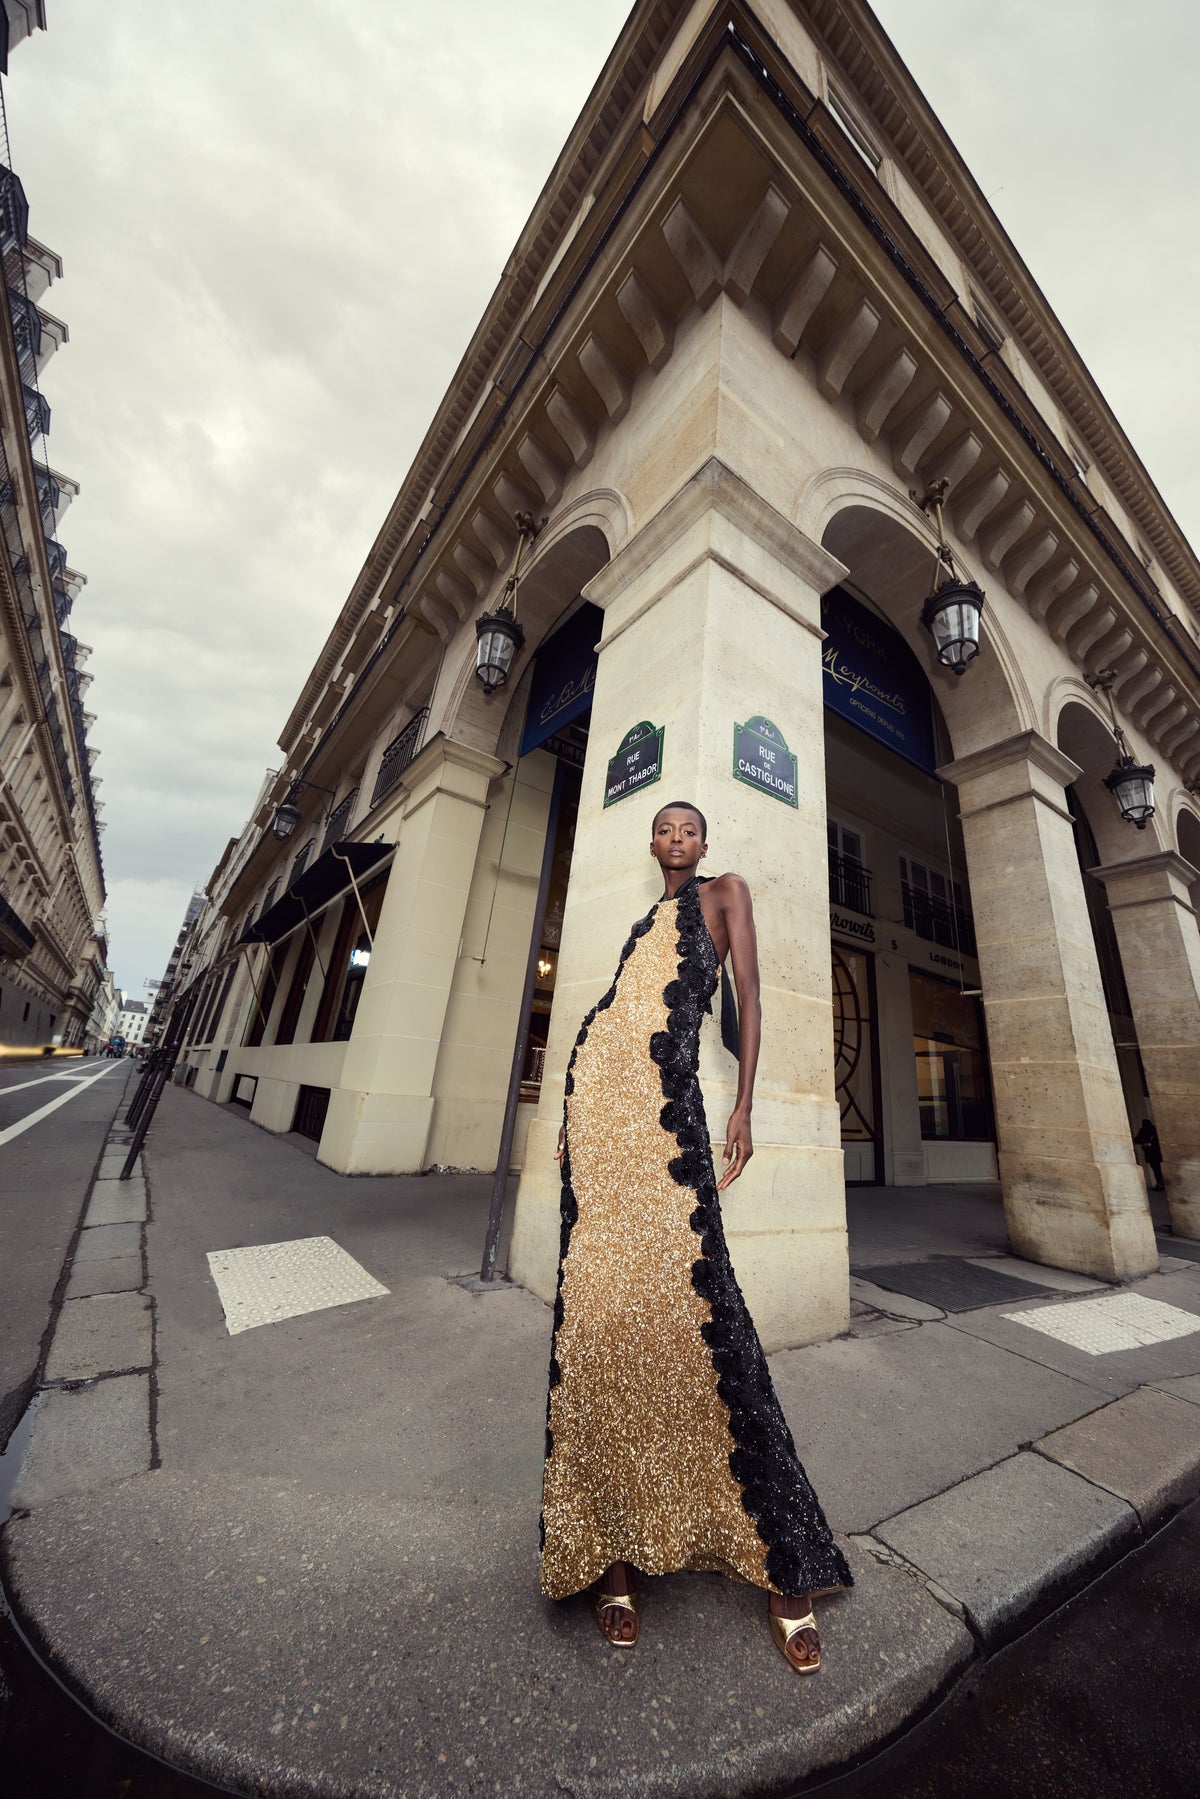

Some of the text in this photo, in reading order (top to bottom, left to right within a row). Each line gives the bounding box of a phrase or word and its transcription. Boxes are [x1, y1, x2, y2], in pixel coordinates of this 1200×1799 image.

[626, 750, 640, 765] RUE
[759, 745, 776, 763] RUE
[763, 761, 771, 770] DE
[607, 763, 658, 797] MONT THABOR
[738, 759, 794, 796] CASTIGLIONE
[891, 940, 898, 950] 5
